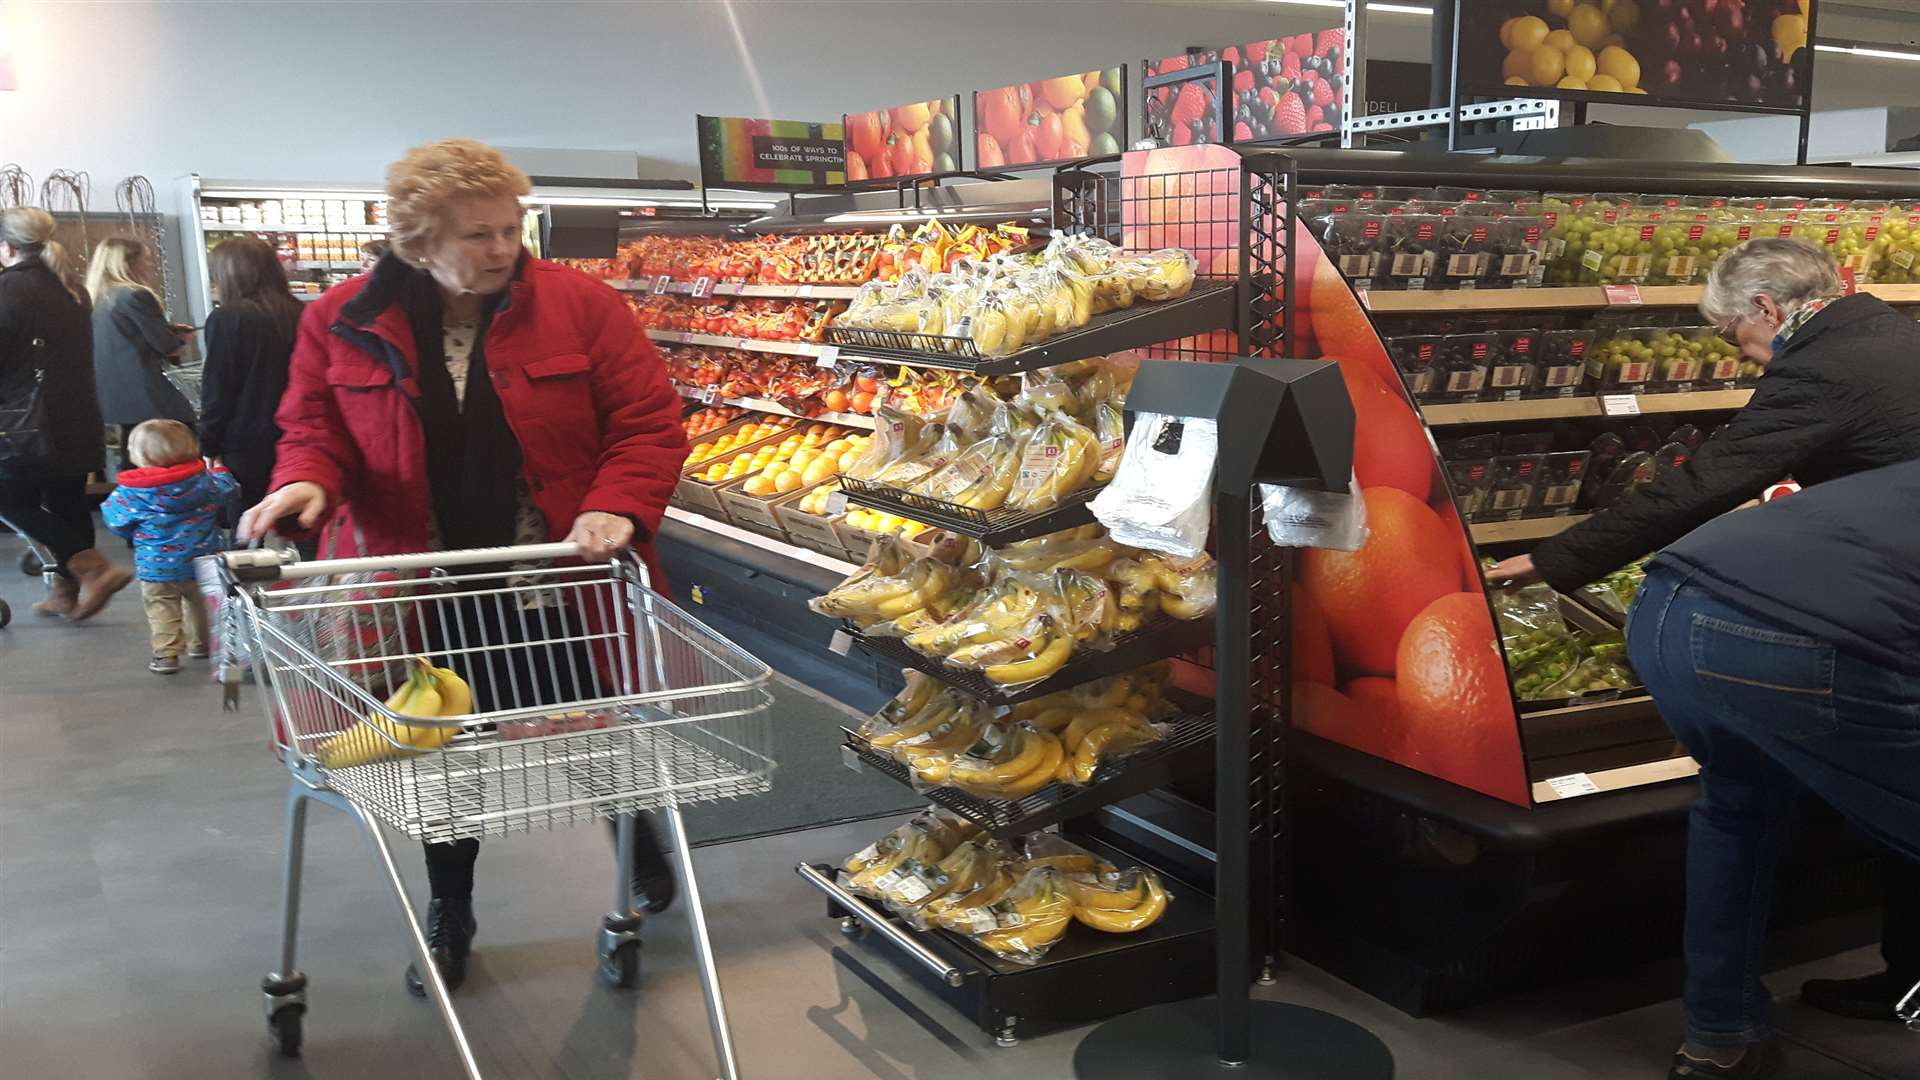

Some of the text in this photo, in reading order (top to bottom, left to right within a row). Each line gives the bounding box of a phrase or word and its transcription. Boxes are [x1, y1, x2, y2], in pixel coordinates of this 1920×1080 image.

[1369, 101, 1398, 113] DELI
[803, 146, 825, 154] WAYS
[827, 147, 838, 155] TO
[759, 153, 803, 162] CELEBRATE
